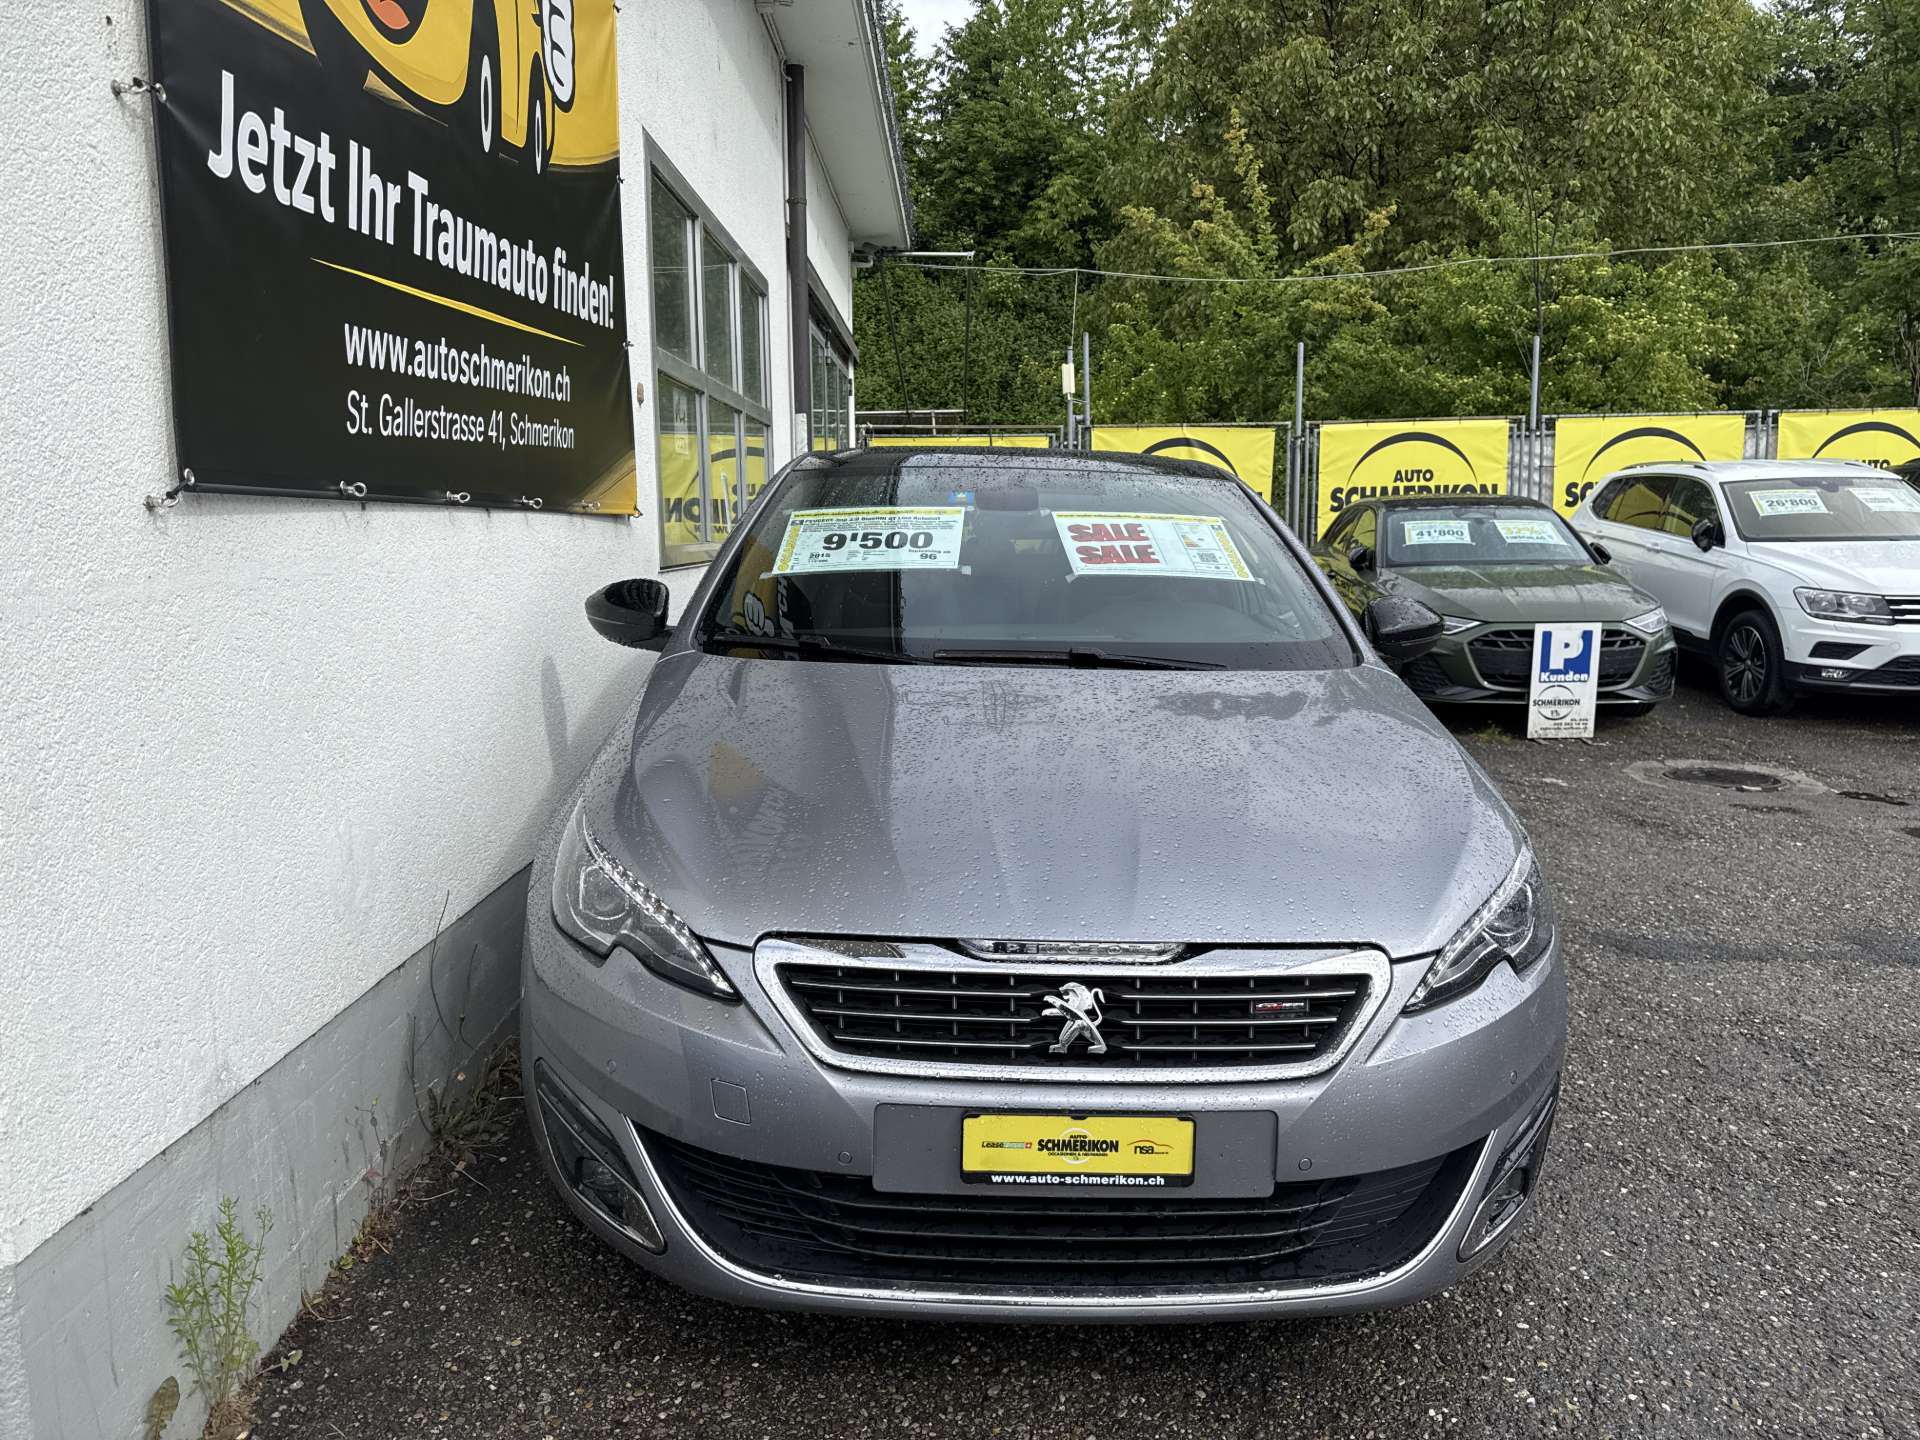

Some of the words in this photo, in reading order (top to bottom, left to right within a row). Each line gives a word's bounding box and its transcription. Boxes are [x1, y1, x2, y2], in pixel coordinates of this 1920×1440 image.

[207, 69, 336, 223] Jetzt
[348, 139, 401, 246] Ihr
[407, 170, 548, 304] Traumauto
[552, 246, 615, 330] finden!
[344, 323, 571, 403] www.autoschmerikon.ch
[347, 390, 373, 435] St.
[379, 393, 485, 443] Gallerstrasse
[488, 409, 506, 450] 41,
[509, 412, 575, 450] Schmerikon
[1393, 469, 1434, 483] AUTO
[1766, 499, 1818, 507] 26'800
[1067, 523, 1150, 542] SALE
[1416, 529, 1464, 537] 41'800
[822, 531, 934, 550] 9'500
[1076, 545, 1161, 564] SALE
[1549, 630, 1584, 670] P
[1540, 671, 1588, 682] Kunden
[1532, 699, 1580, 707] SCHMERIKON
[1037, 1139, 1119, 1152] SCHMERIKON
[1134, 1146, 1154, 1154] nsa
[991, 1173, 1165, 1185] www.auto-schmerikon.ch
